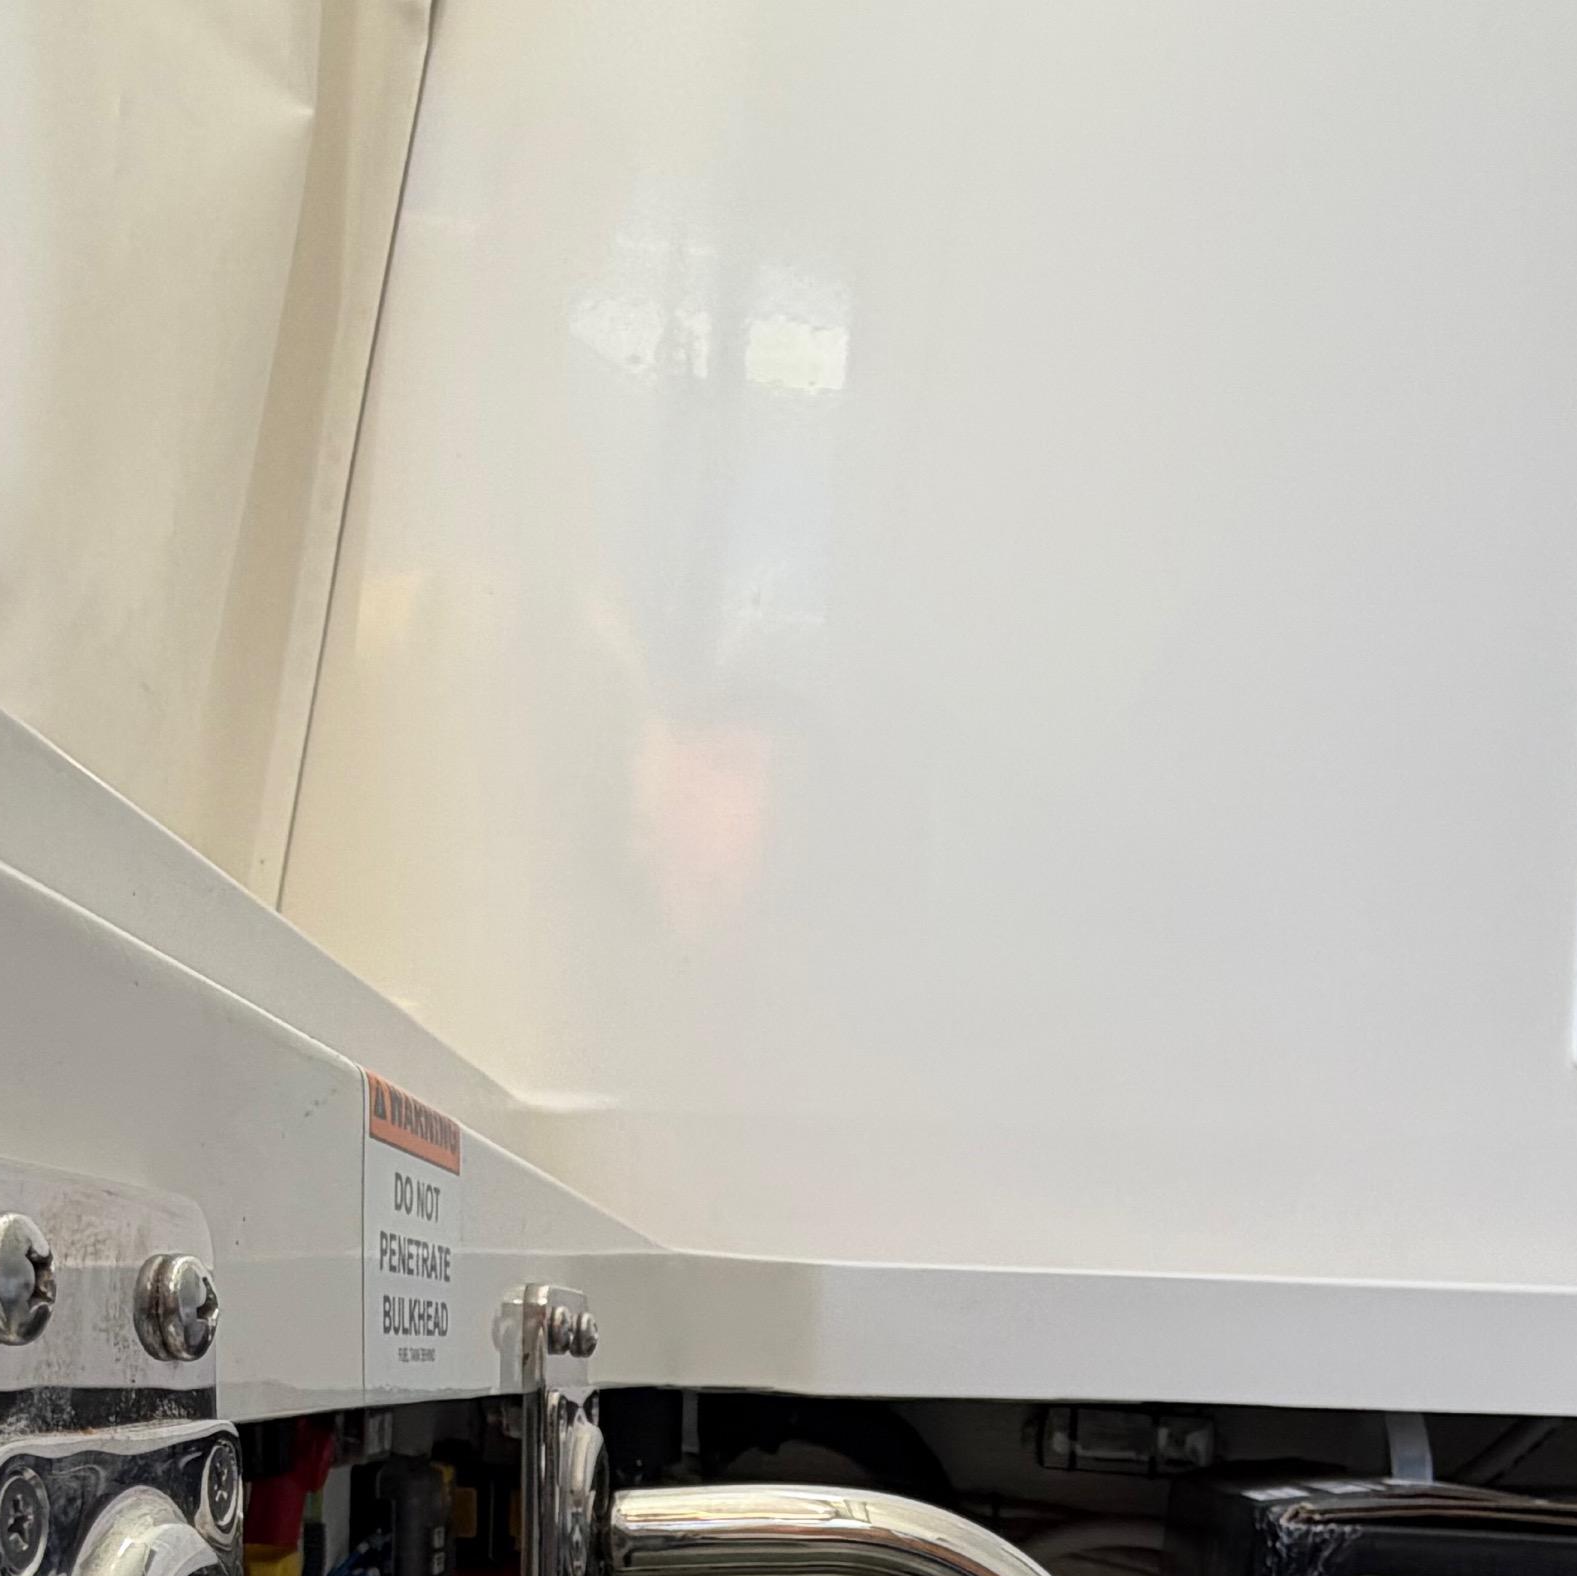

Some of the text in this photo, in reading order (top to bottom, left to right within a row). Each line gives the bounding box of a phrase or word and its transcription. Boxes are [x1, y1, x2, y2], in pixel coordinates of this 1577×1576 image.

[390, 1086, 459, 1155] WARNING
[394, 1172, 441, 1223] DO NOT
[379, 1230, 451, 1283] PENETRATE
[383, 1295, 449, 1337] BULKHEAD
